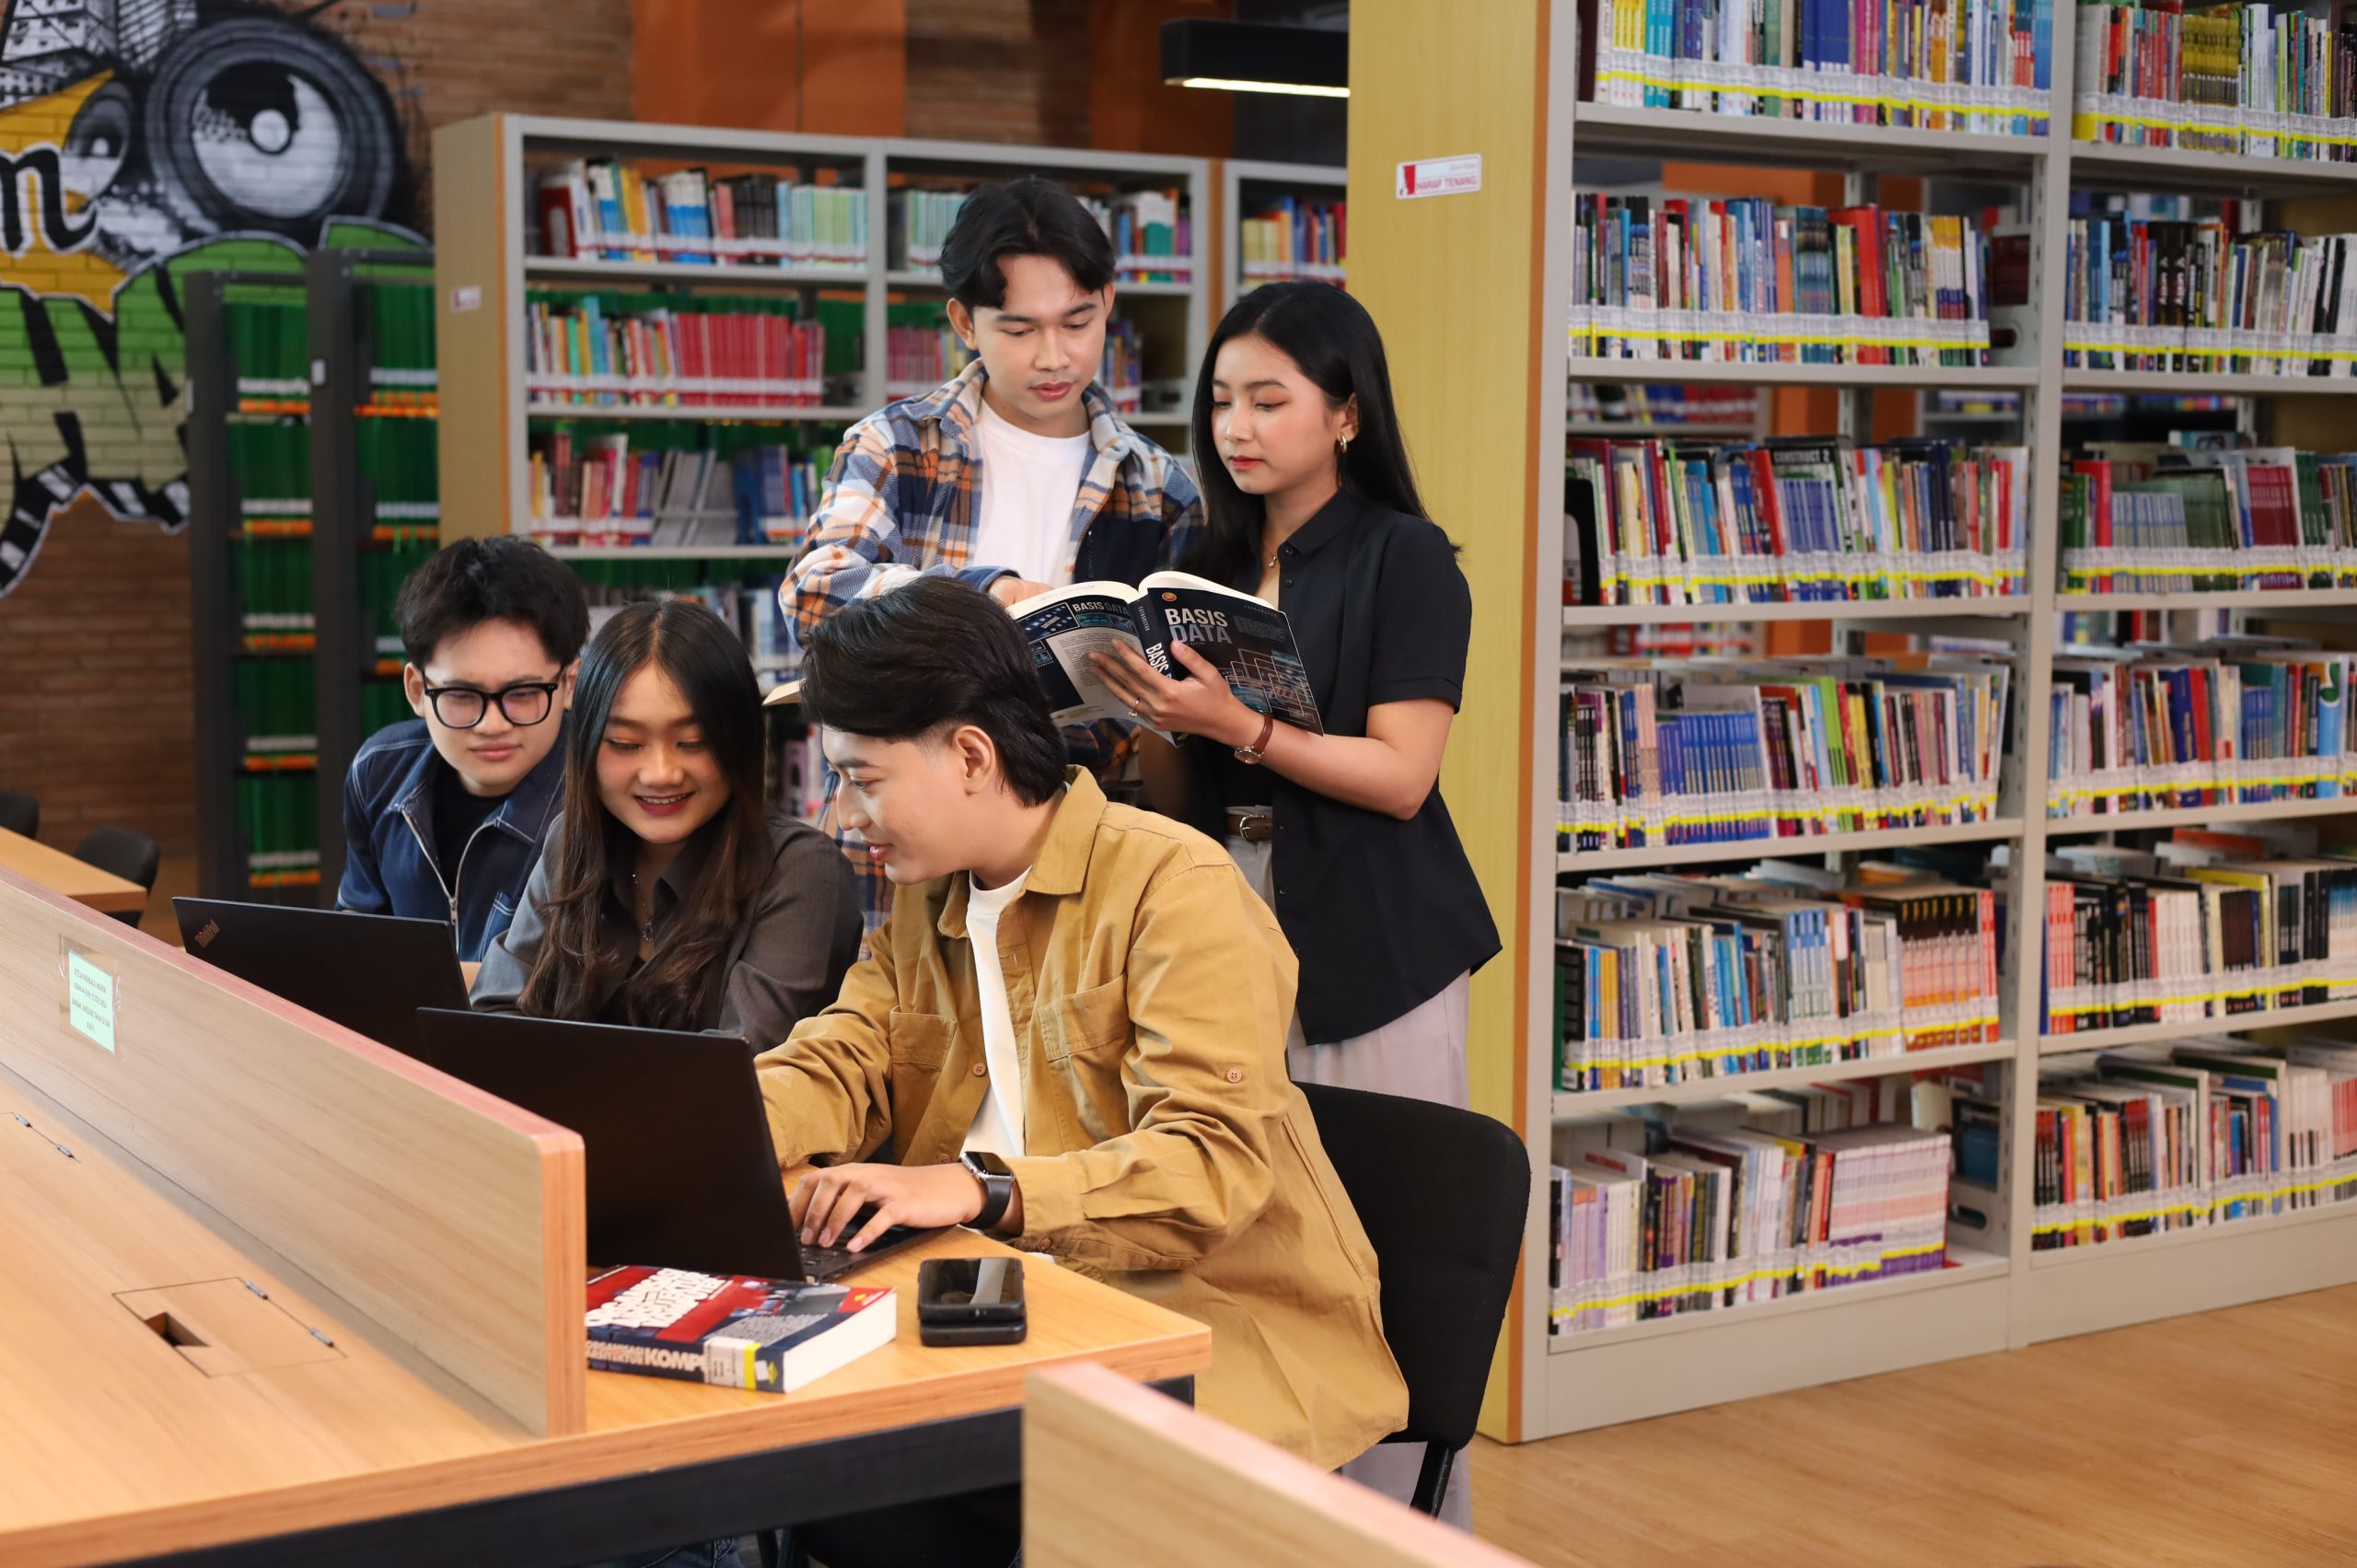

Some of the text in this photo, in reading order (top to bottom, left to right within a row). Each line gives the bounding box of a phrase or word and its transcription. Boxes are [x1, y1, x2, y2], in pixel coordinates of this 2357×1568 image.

[1073, 601, 1130, 616] BASIS DATA
[1164, 608, 1228, 627] BASIS
[1169, 623, 1234, 645] DATA
